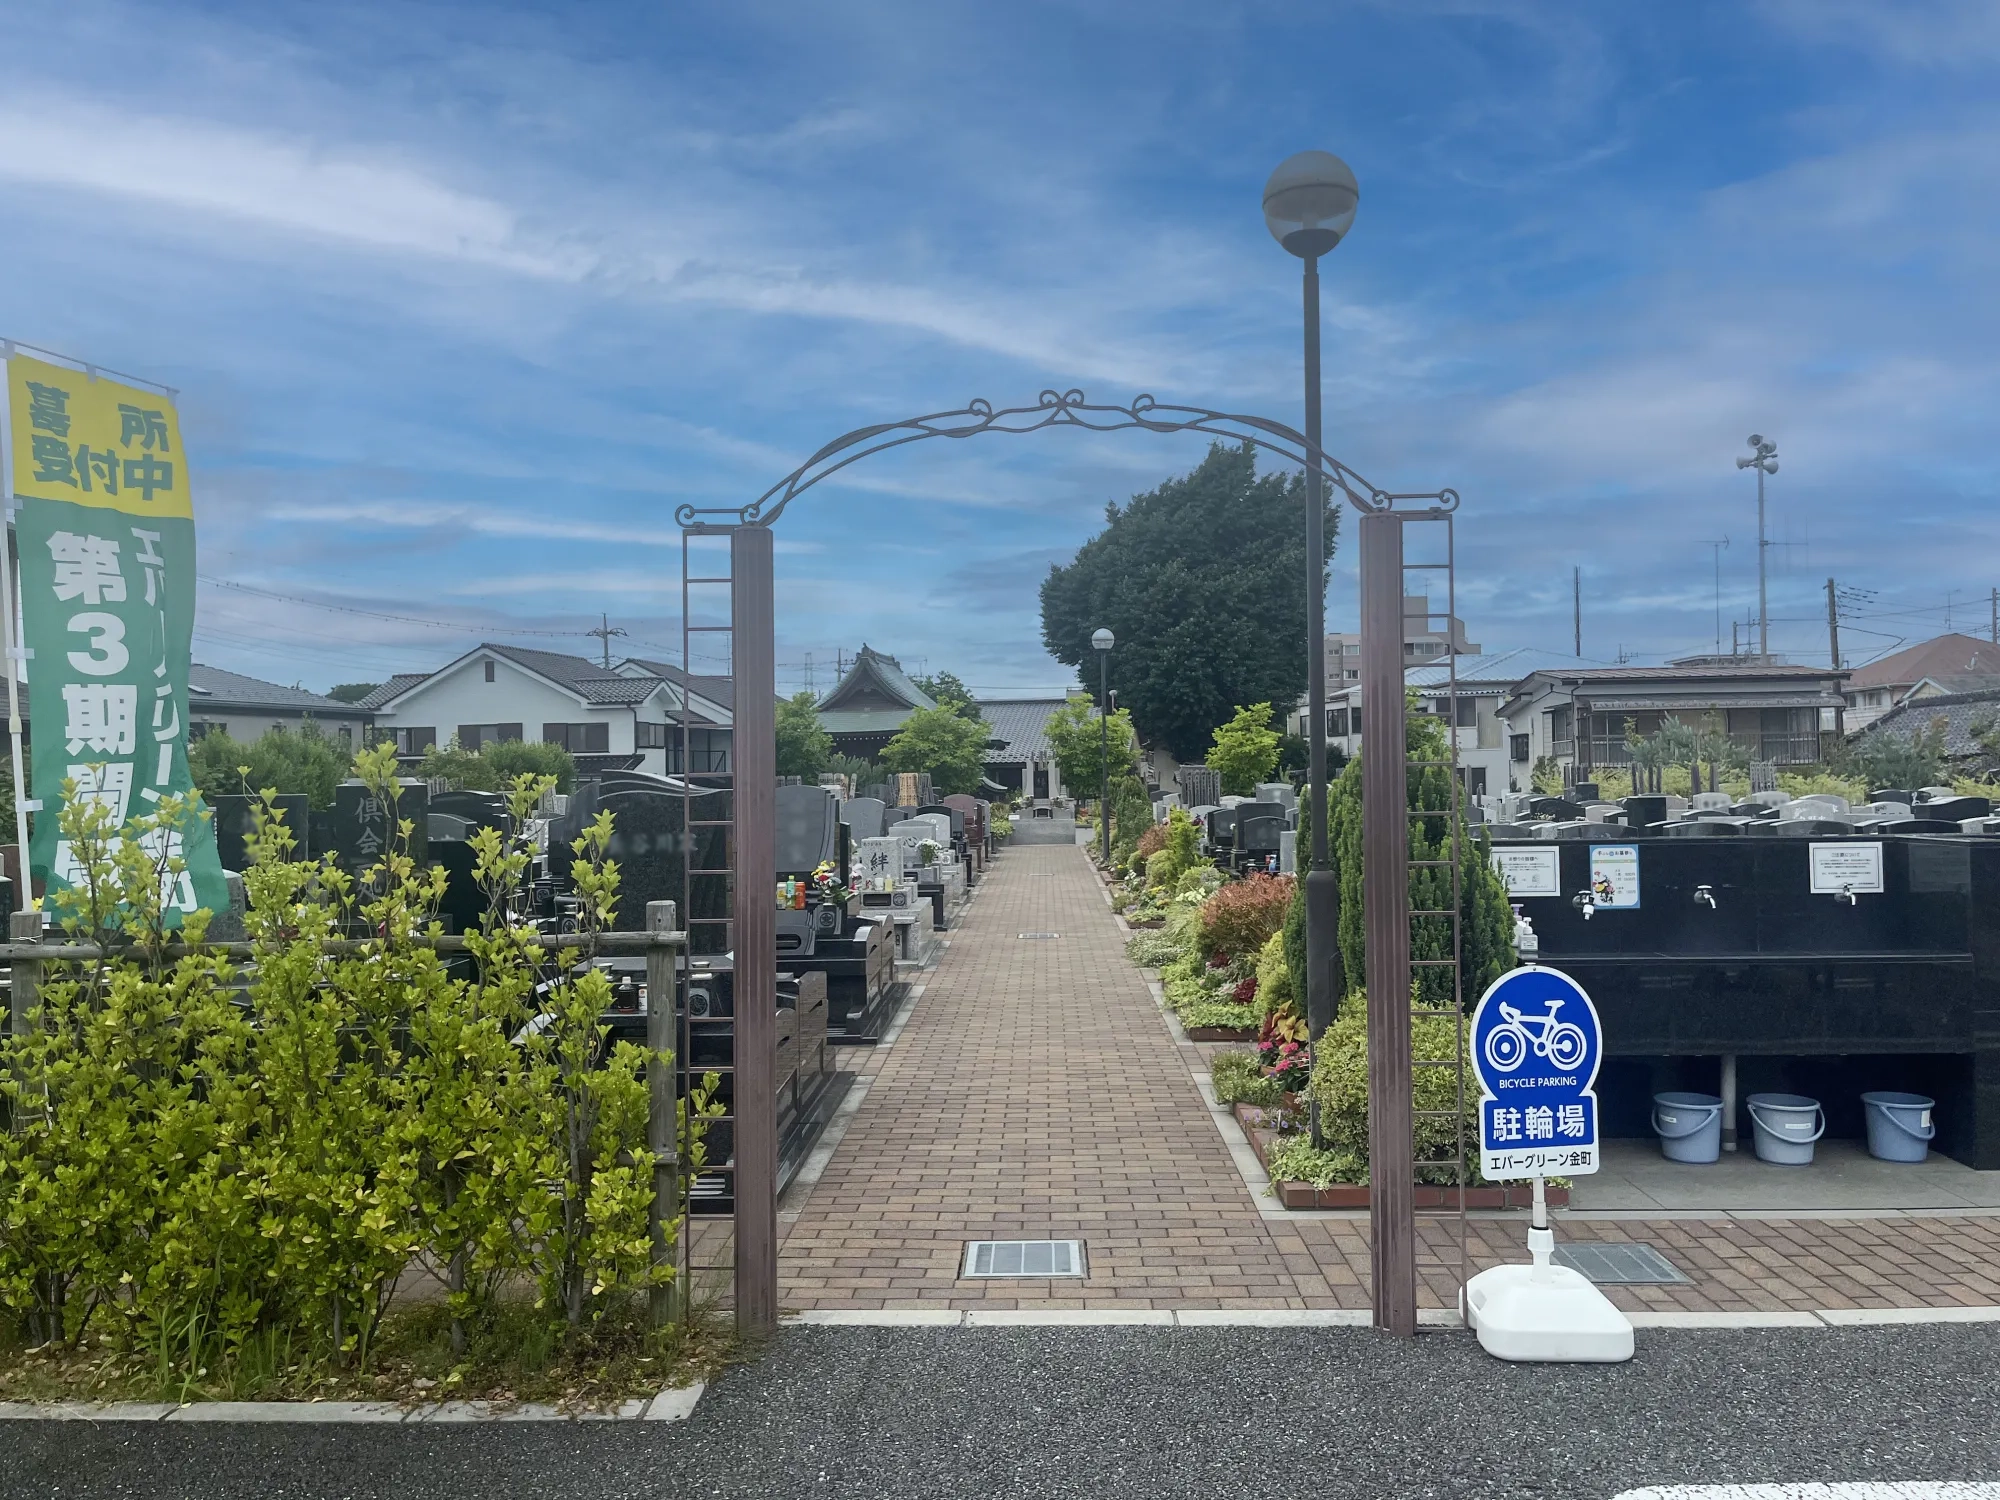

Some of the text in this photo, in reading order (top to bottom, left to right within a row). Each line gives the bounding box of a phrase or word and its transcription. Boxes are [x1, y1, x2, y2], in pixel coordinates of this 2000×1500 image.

[31, 434, 173, 501] 受付中
[870, 851, 889, 872] 絆
[1499, 1076, 1577, 1089] BICYCLE PARKING
[1492, 1104, 1586, 1142] 駐輪場
[1490, 1151, 1592, 1170] エバーグリーン金町
